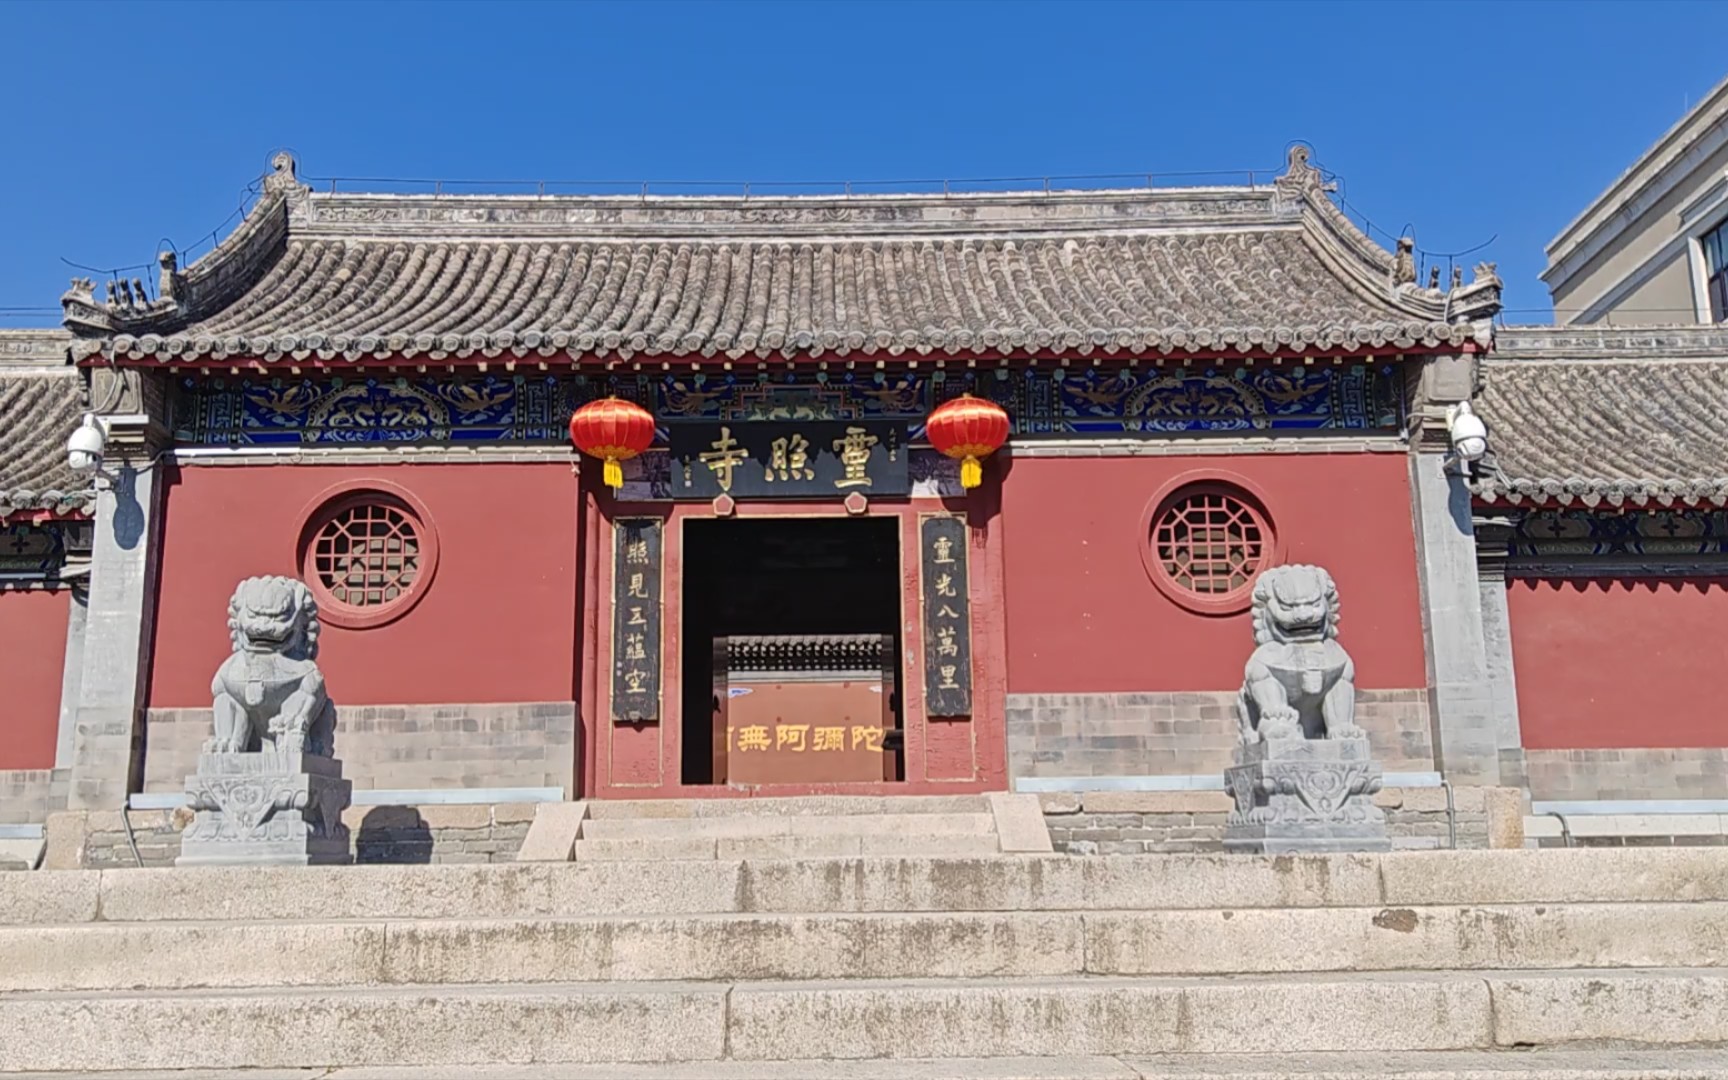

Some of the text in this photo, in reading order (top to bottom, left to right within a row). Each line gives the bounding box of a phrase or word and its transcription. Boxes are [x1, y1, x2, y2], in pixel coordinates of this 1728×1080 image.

[933, 536, 960, 689] 靈光八萬里
